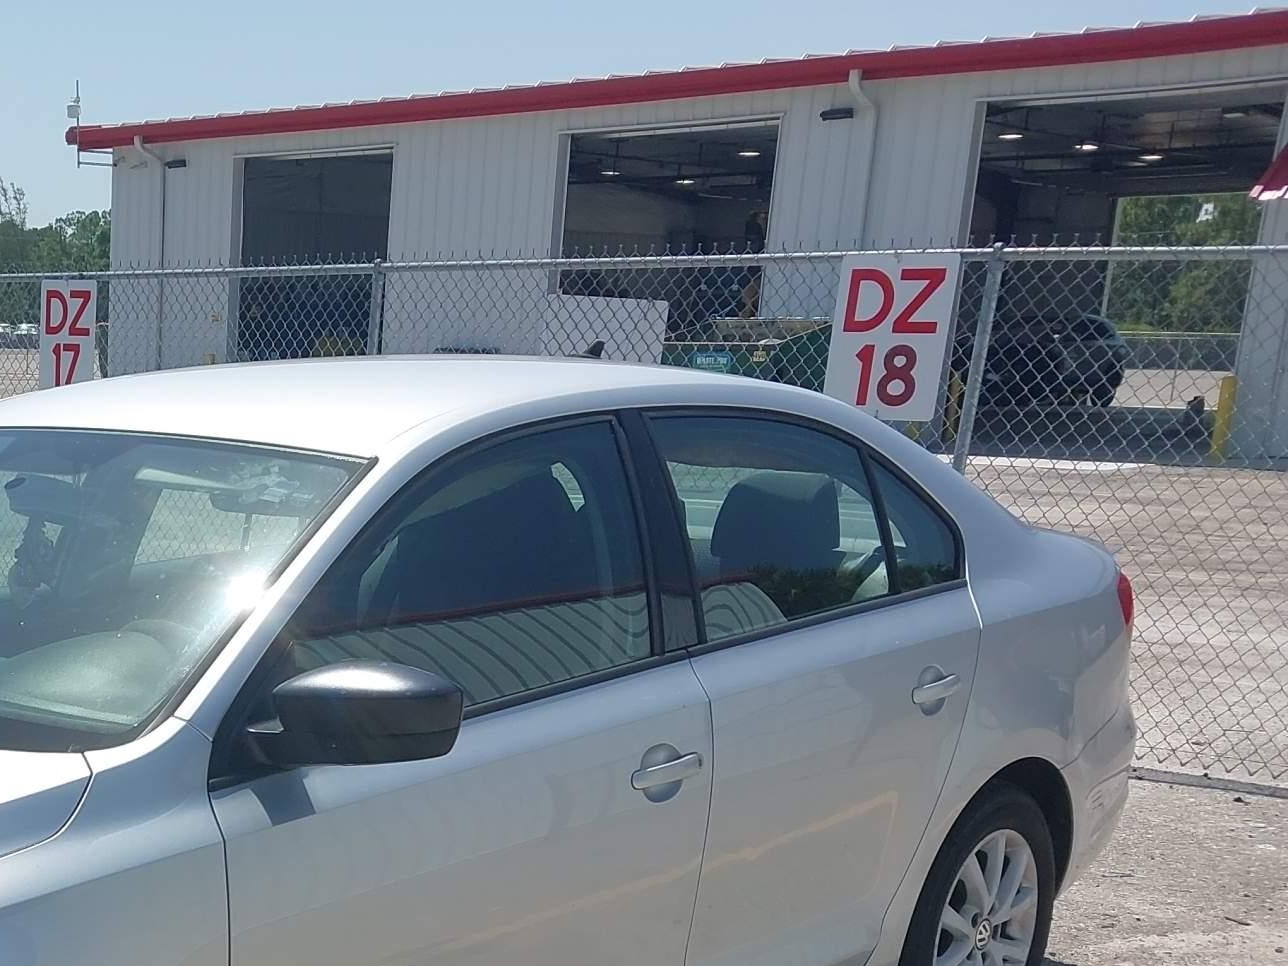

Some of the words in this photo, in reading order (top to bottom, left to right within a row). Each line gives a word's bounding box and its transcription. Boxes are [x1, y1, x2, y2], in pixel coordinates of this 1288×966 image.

[45, 289, 92, 337] DZ
[843, 267, 947, 334] DZ
[52, 343, 81, 387] 17
[855, 343, 917, 407] 18
